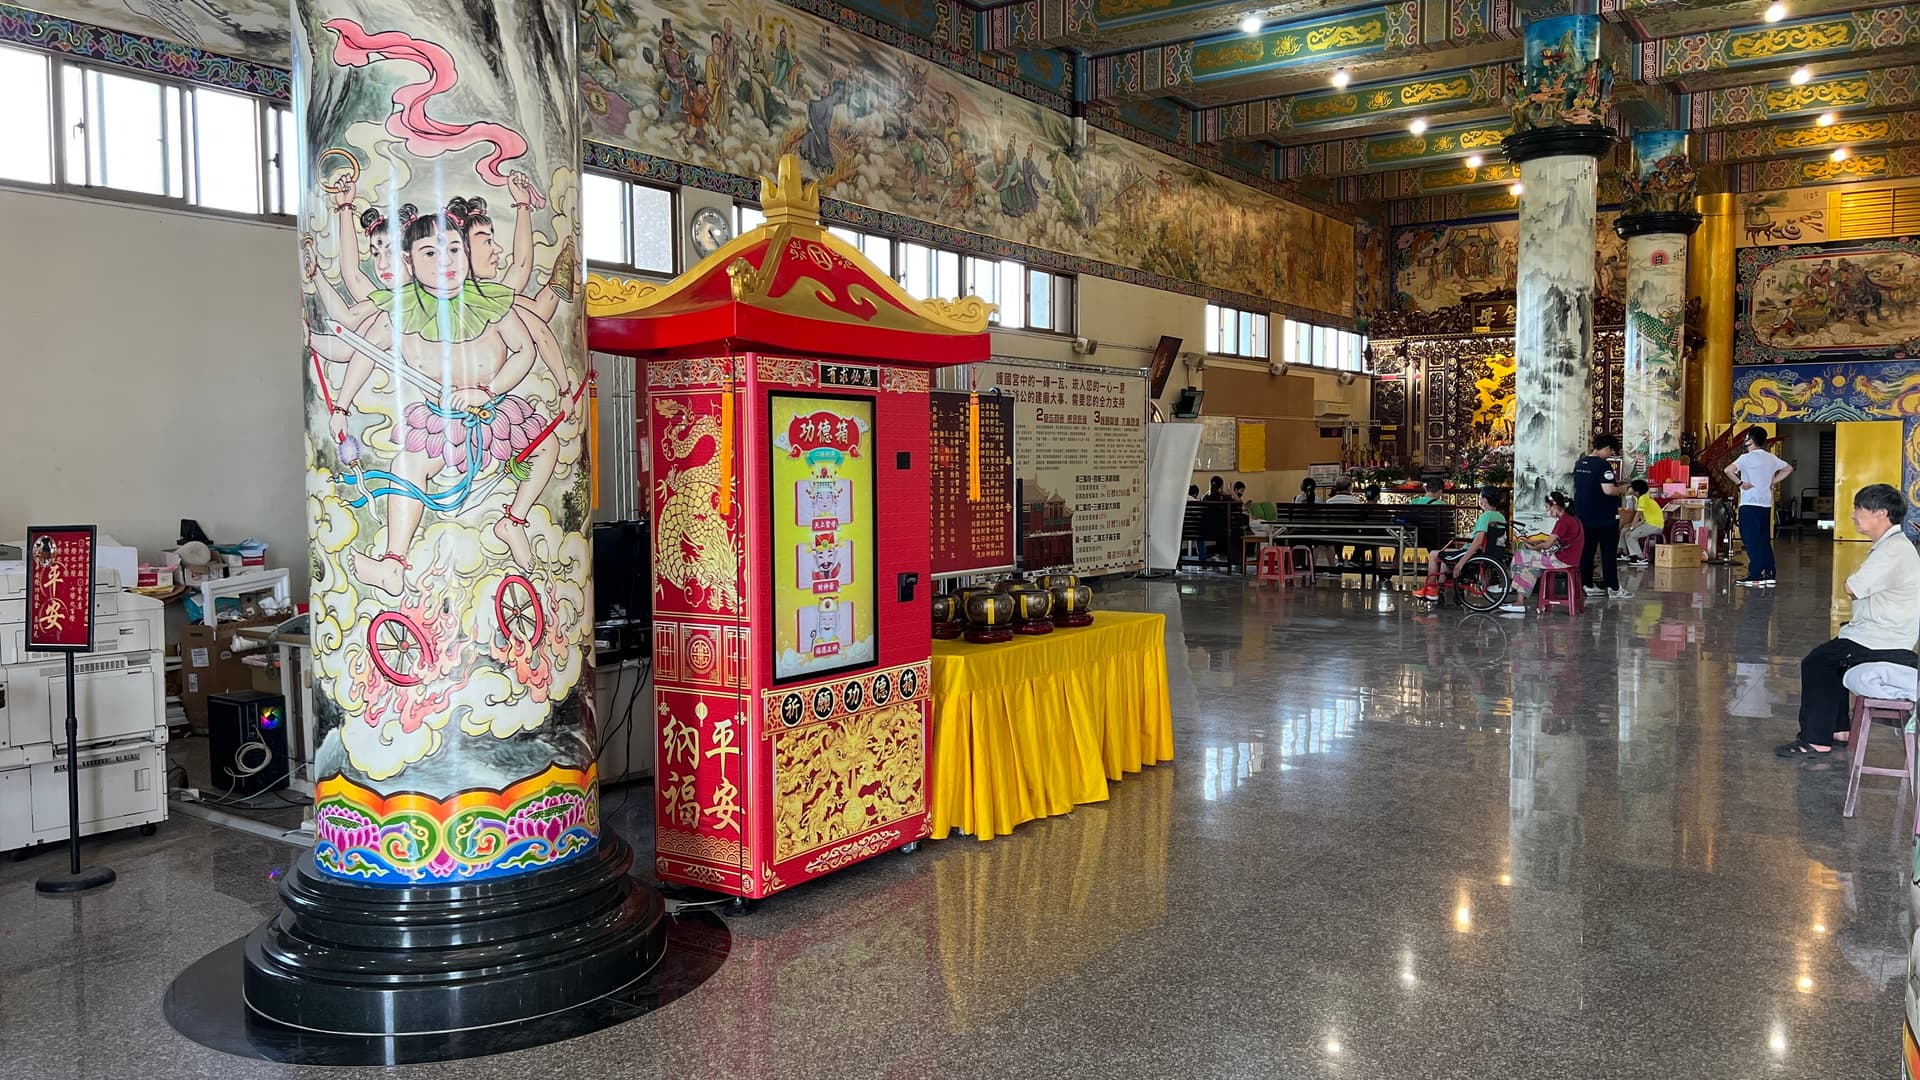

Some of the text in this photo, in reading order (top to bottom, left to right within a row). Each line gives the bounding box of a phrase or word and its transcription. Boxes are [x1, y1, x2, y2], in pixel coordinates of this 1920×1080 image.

[826, 365, 873, 386] 有求必應
[799, 418, 849, 445] 功德箱
[39, 563, 66, 631] 平安
[661, 714, 700, 830] 納福
[703, 718, 745, 834] 平安
